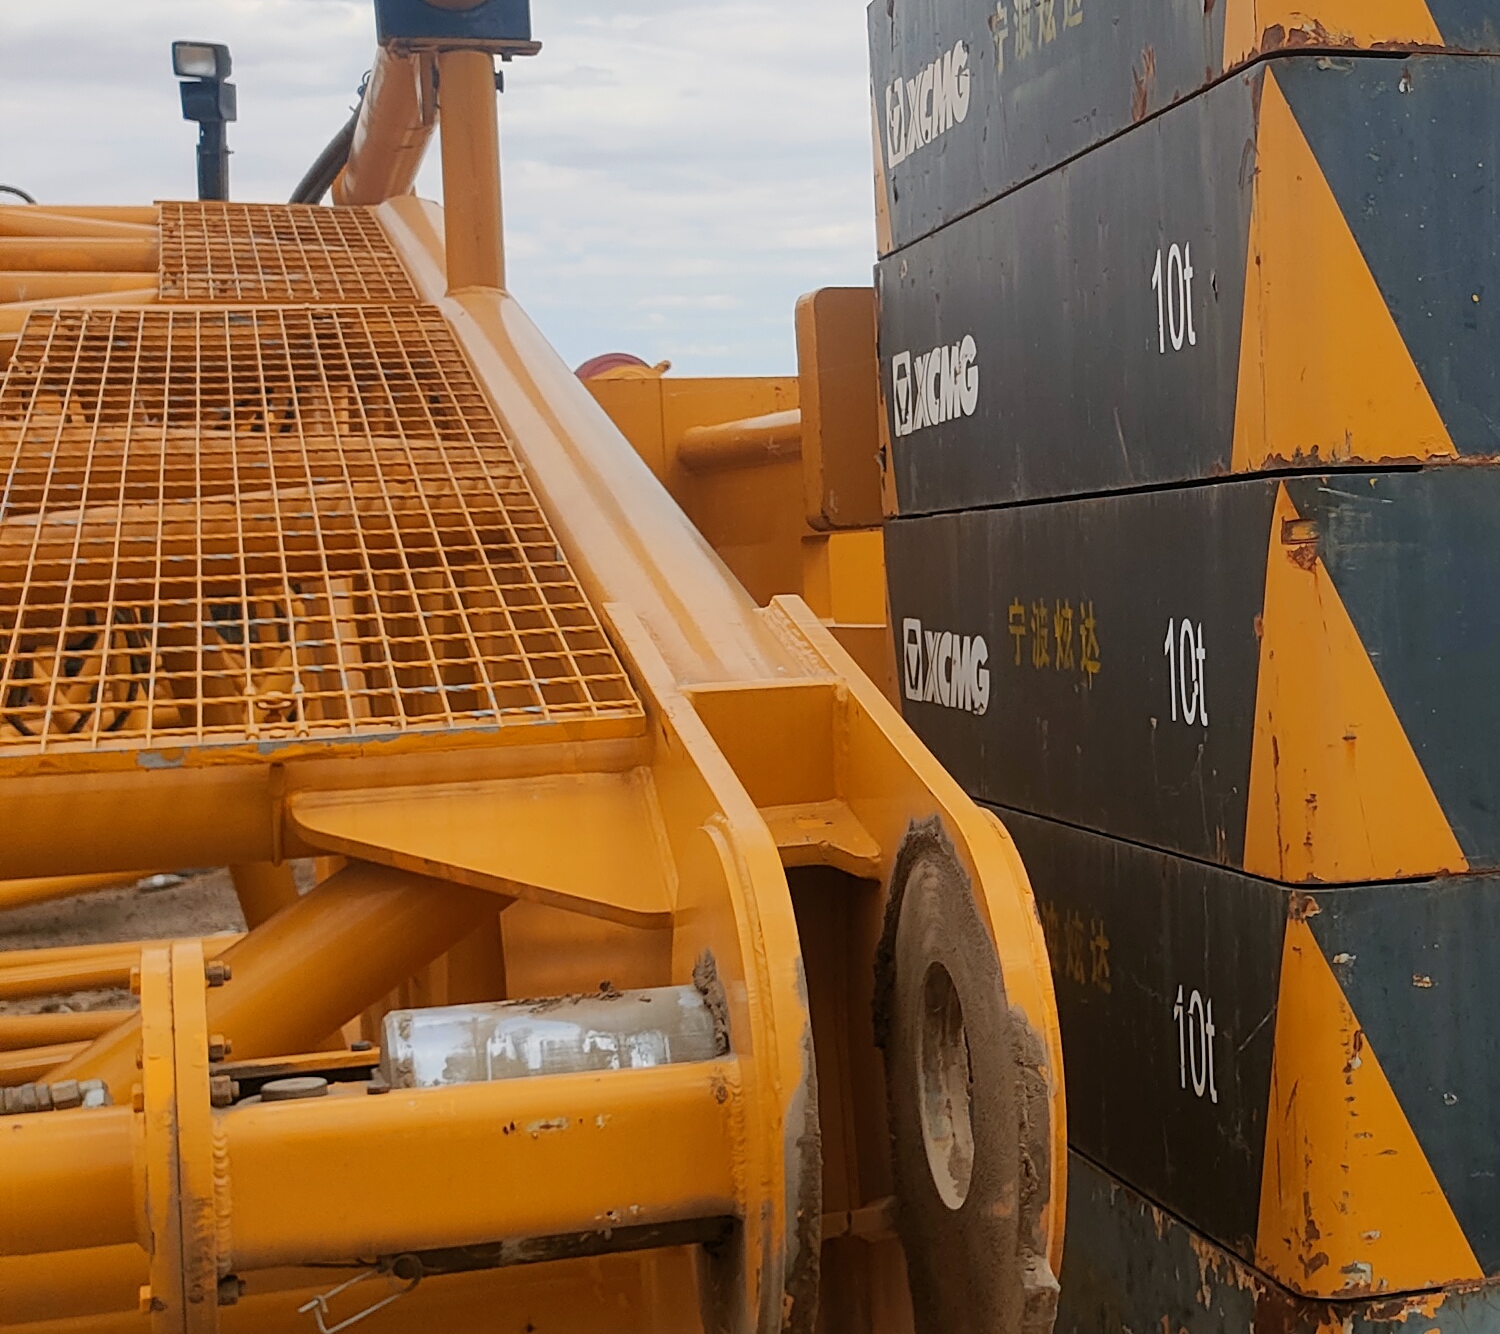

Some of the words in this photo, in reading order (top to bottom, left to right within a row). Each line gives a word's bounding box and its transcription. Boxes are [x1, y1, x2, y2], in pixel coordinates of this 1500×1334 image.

[905, 40, 970, 154] XCMG
[1151, 241, 1196, 354] 10t
[913, 334, 979, 430] XCMG
[923, 630, 990, 716] XCMG
[1163, 617, 1208, 727] 10t
[1173, 984, 1217, 1104] 10t
